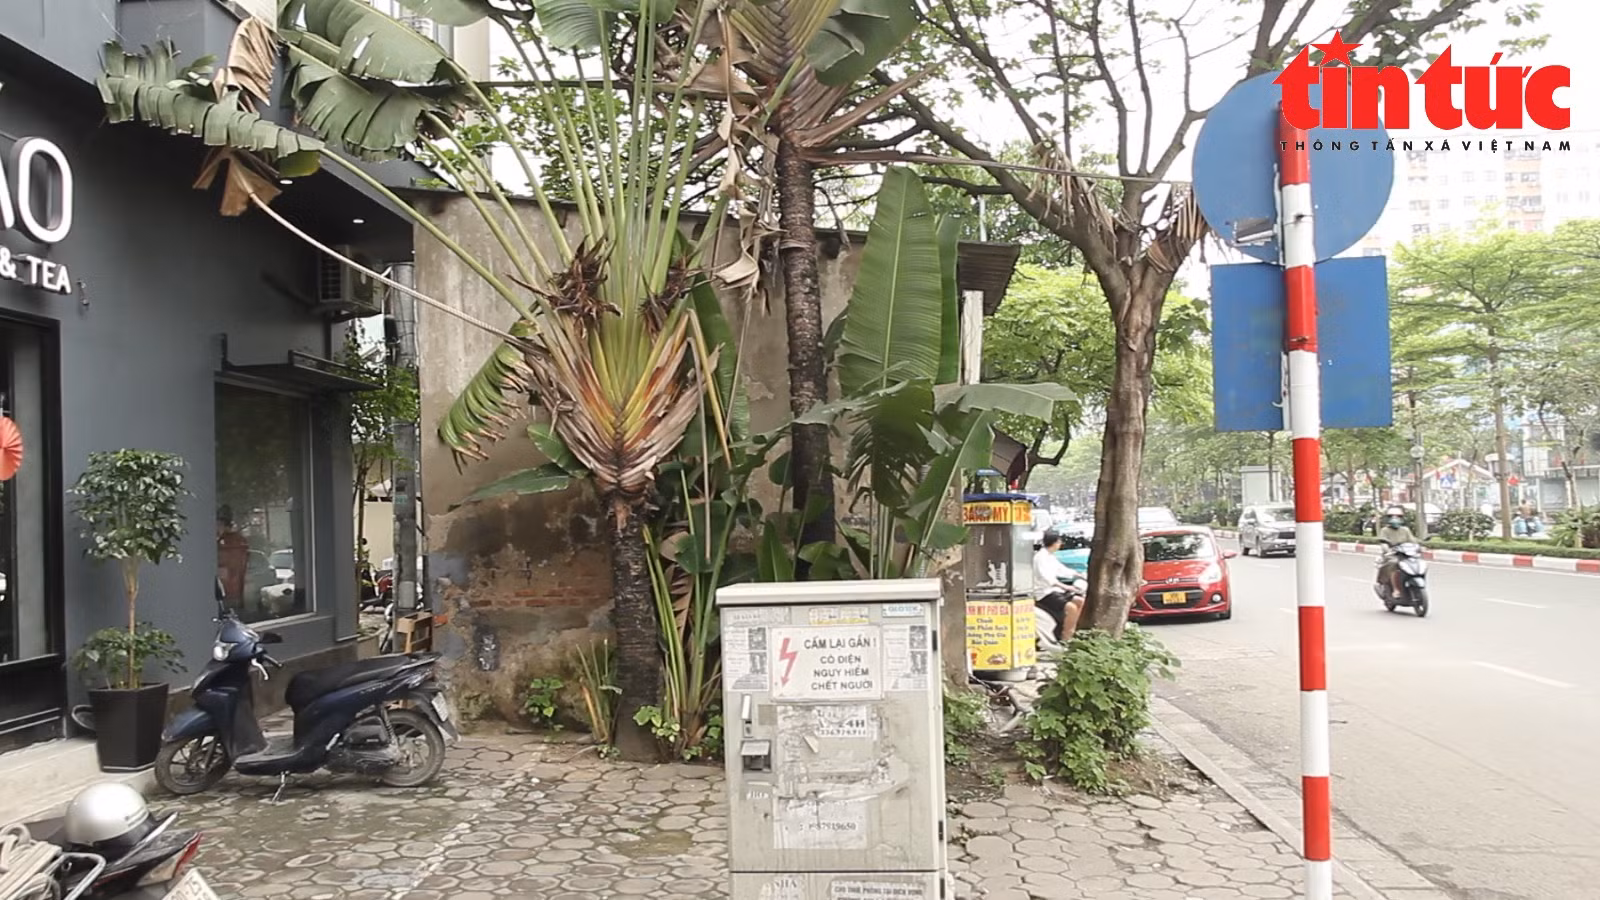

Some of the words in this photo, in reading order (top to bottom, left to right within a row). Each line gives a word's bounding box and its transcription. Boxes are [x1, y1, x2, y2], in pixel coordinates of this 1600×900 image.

[27, 255, 72, 294] TEA
[804, 635, 827, 649] CẤM
[814, 669, 841, 677] NGUY
[811, 680, 837, 690] CHẾT
